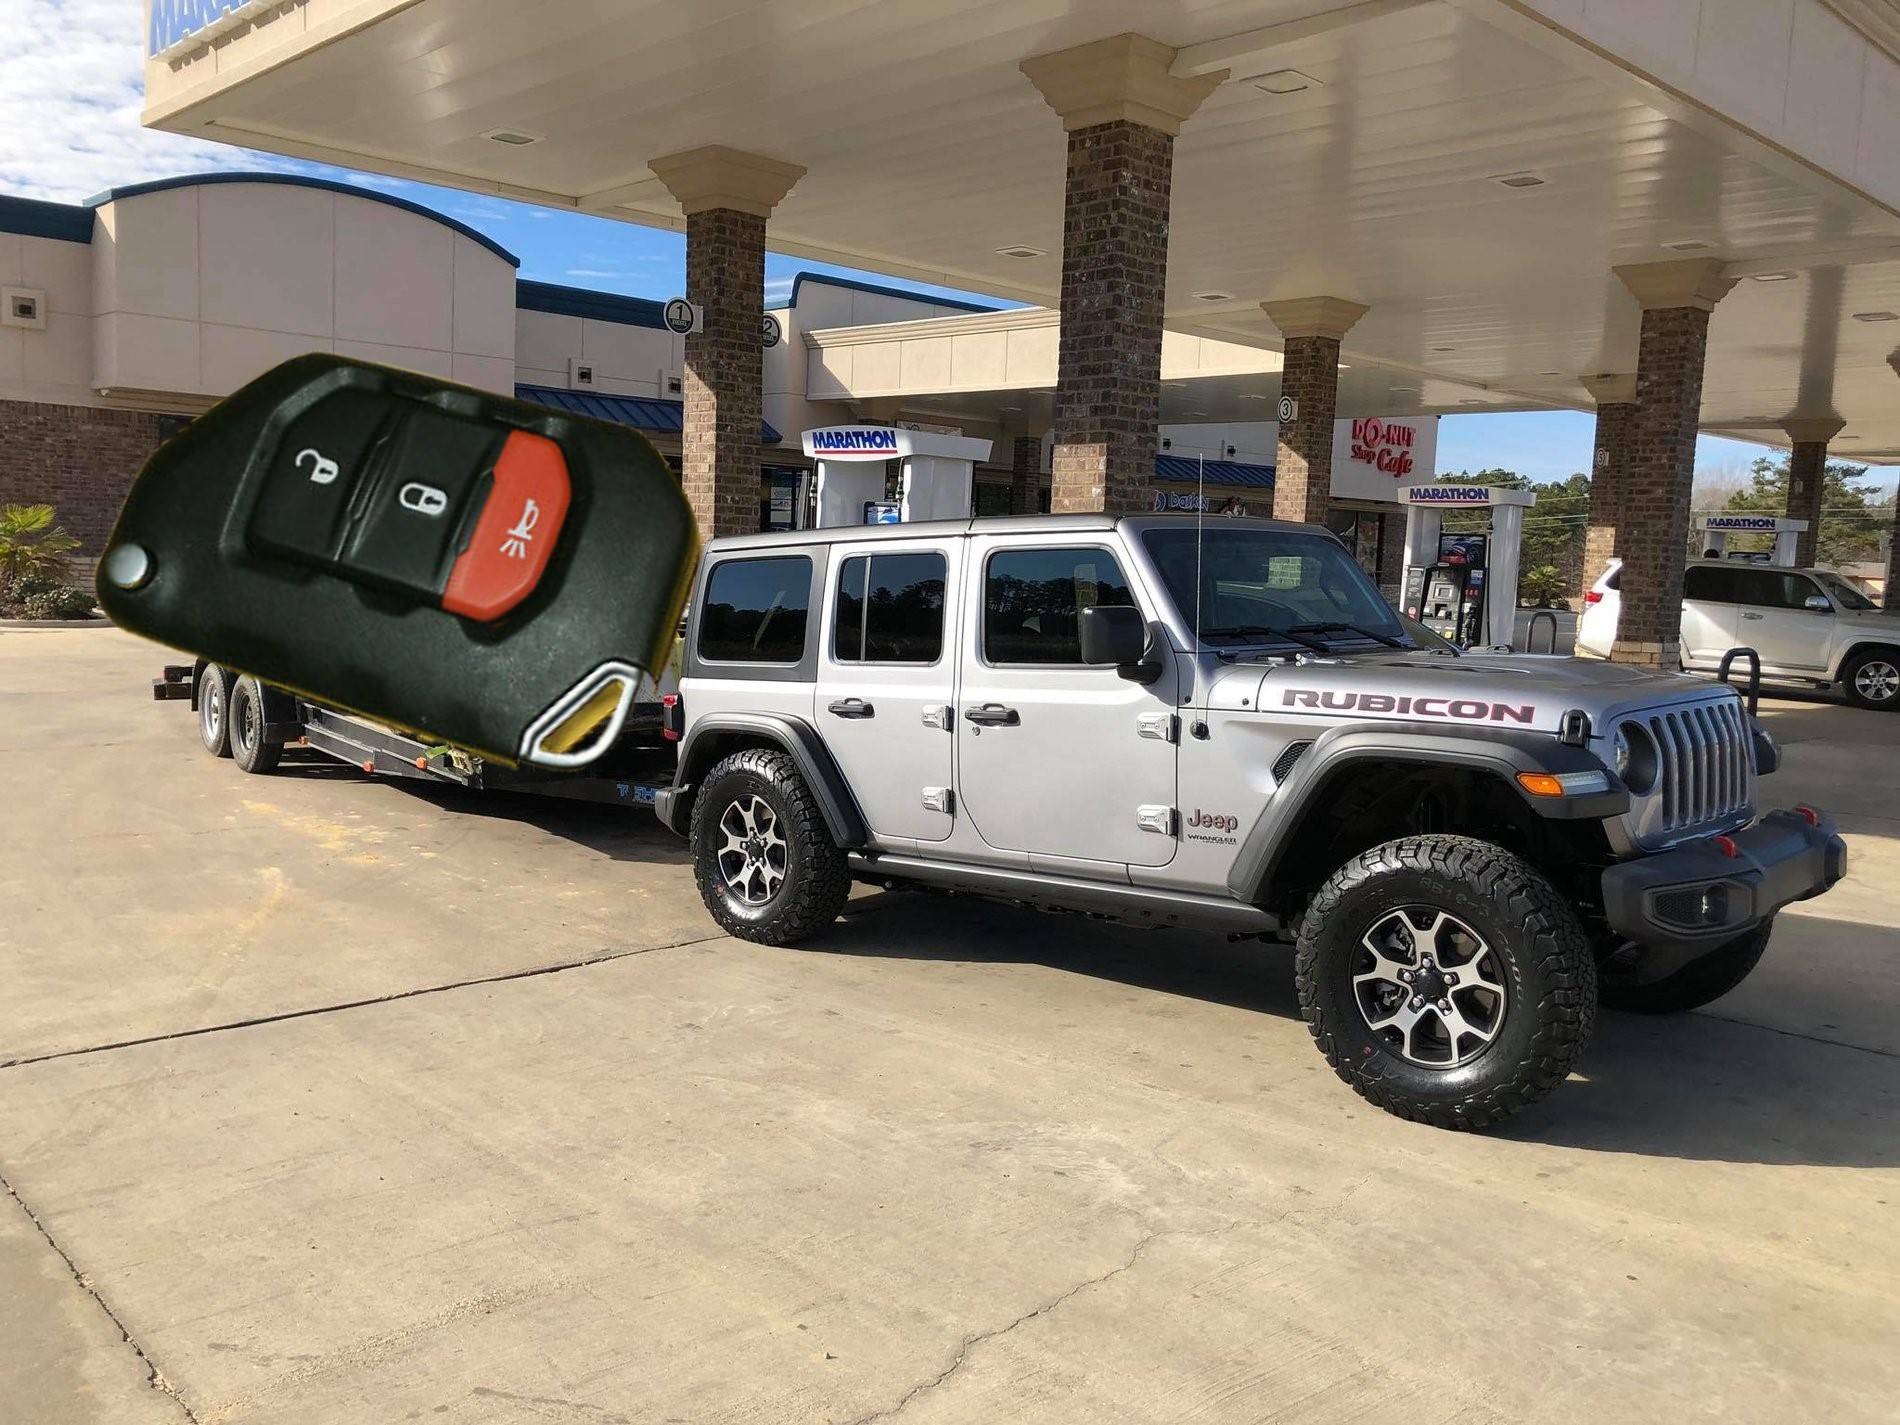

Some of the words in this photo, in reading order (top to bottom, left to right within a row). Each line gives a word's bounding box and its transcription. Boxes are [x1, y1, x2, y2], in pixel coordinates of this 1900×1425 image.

[812, 430, 897, 449] MARATHON
[1409, 487, 1490, 500] MARATHON
[1706, 518, 1776, 528] MARATHON
[1282, 688, 1536, 724] RUBICON
[1187, 809, 1238, 833] Jeep
